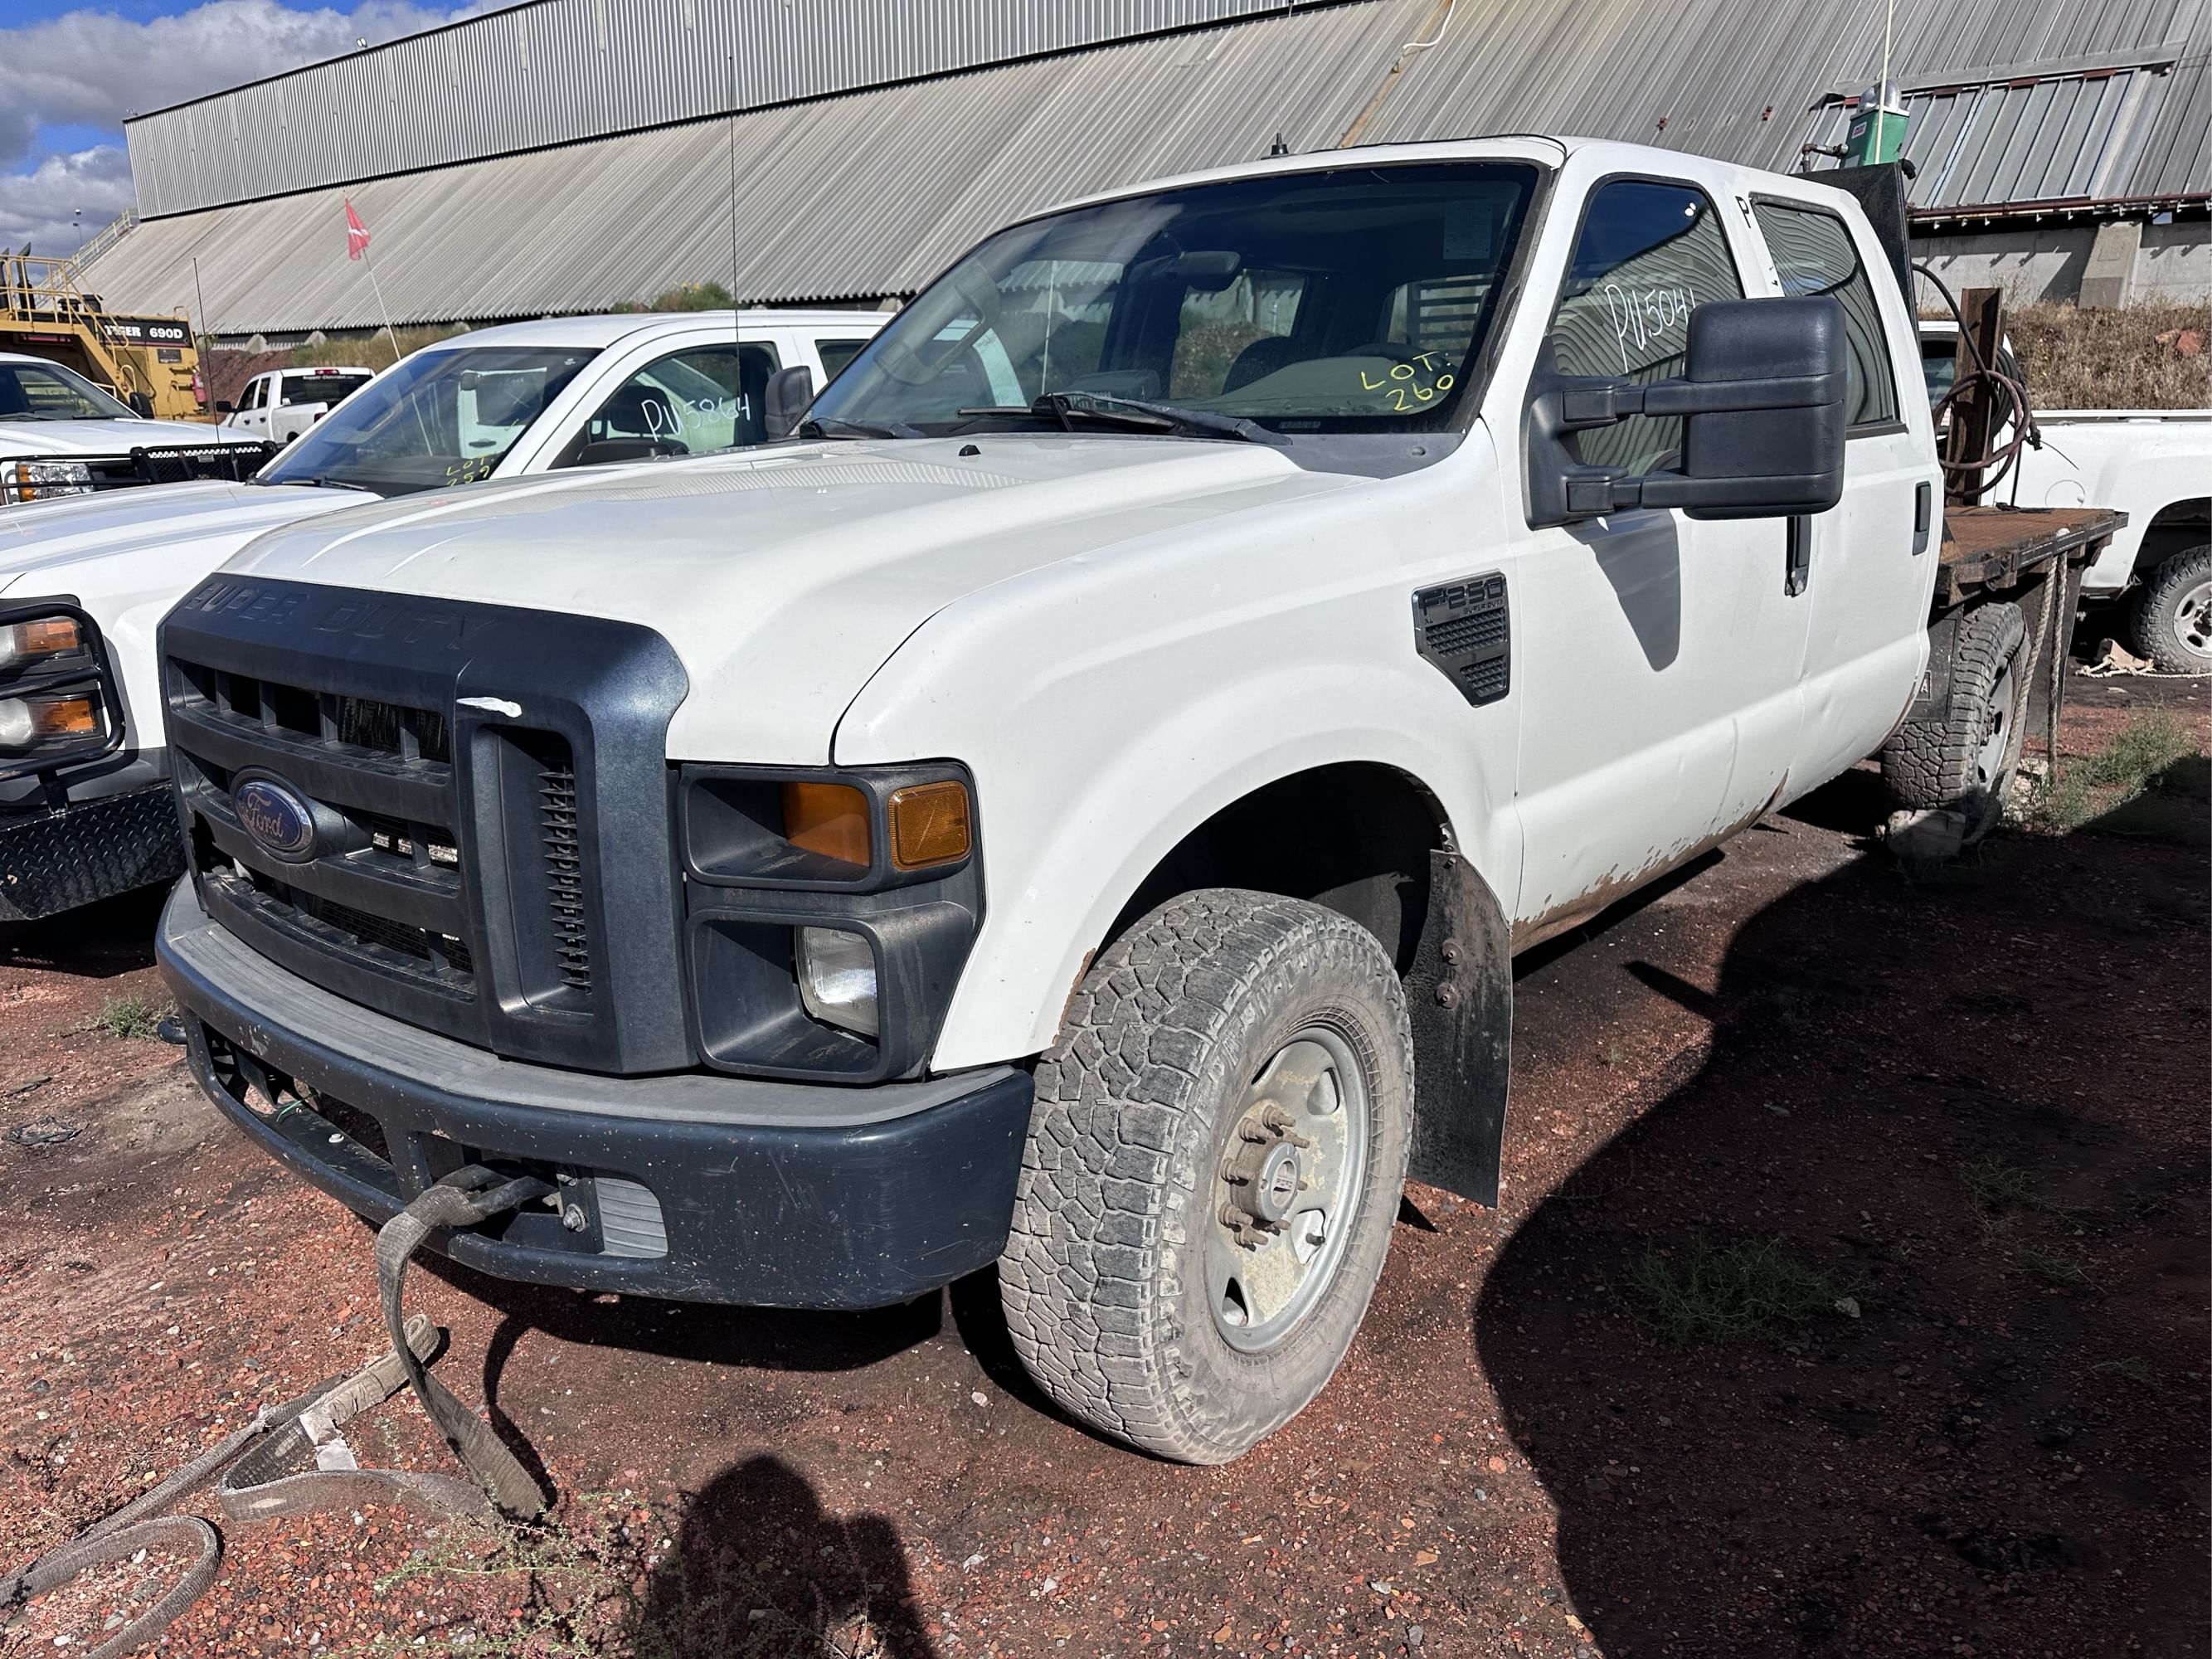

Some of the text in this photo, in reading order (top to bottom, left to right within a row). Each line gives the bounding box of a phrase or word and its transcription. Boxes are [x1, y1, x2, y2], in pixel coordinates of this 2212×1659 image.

[149, 327, 183, 339] 690D
[1384, 374, 1454, 411] 260
[312, 599, 501, 650] DUTY
[247, 792, 284, 838] Ford
